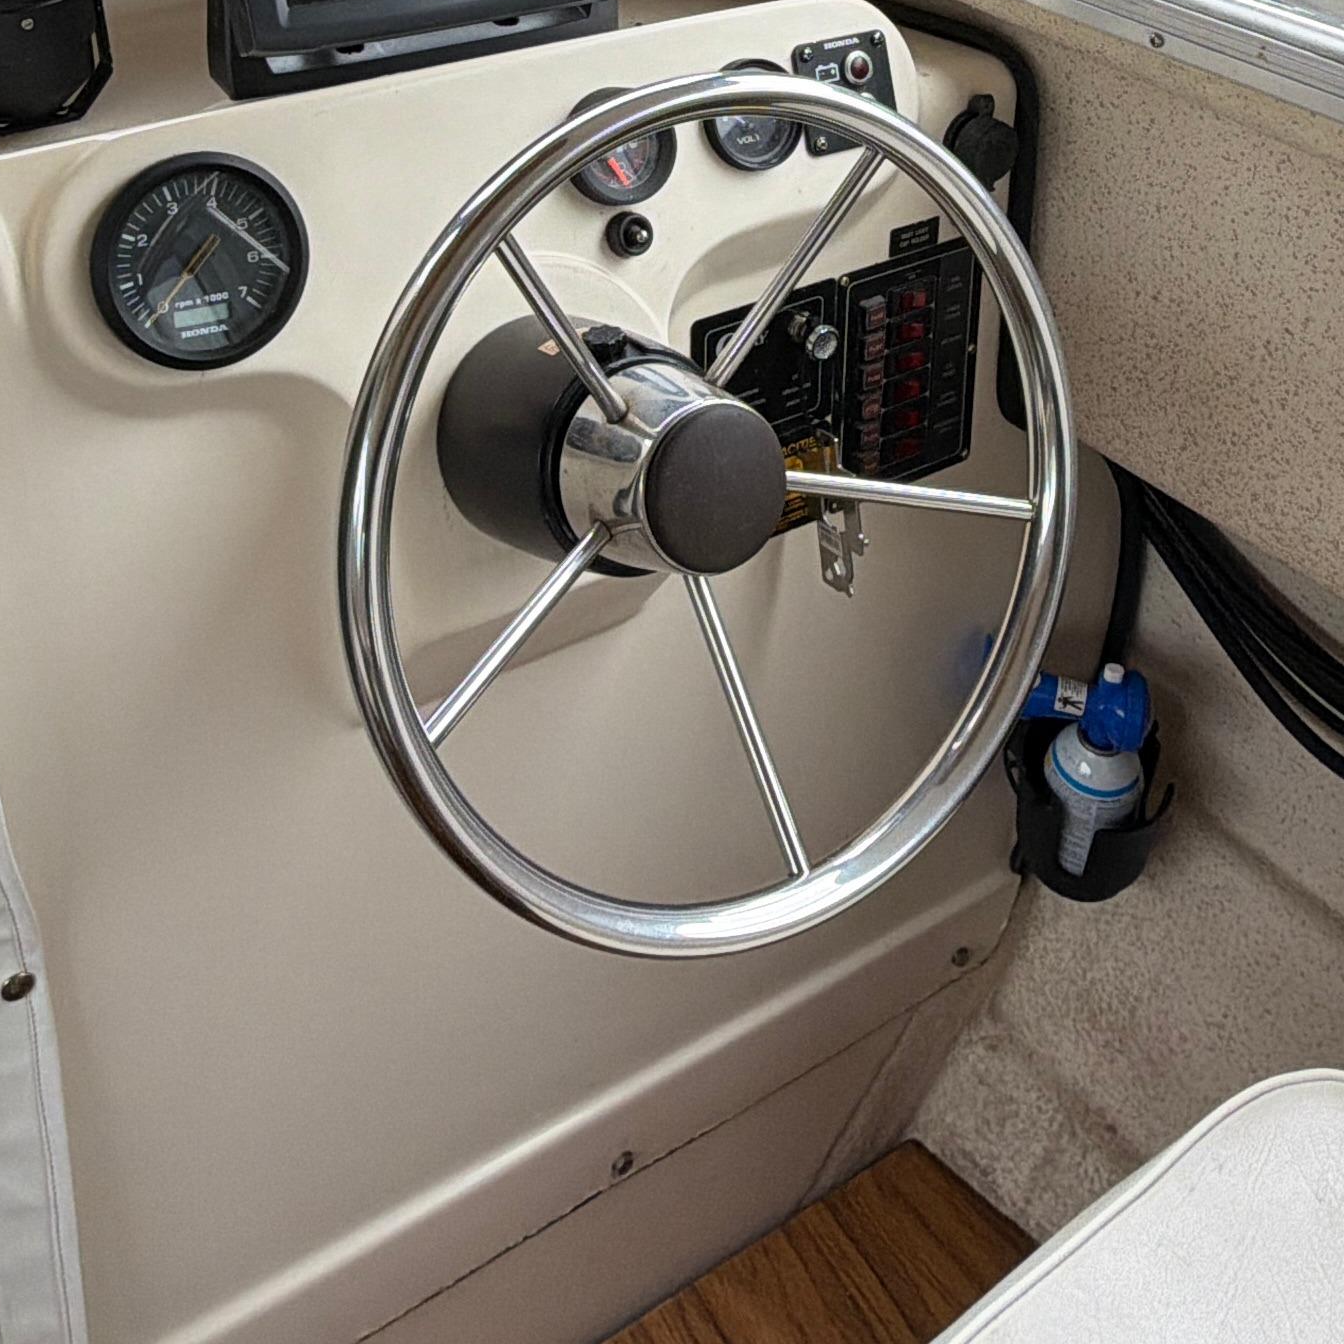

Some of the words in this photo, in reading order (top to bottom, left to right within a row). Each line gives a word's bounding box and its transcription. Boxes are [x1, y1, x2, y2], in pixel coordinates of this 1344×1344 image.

[823, 37, 860, 50] HONDA
[206, 196, 217, 208] 4
[166, 202, 179, 216] 3
[236, 217, 248, 231] 5
[137, 234, 150, 248] 2
[246, 250, 259, 263] 6
[135, 273, 144, 286] 1
[238, 286, 249, 299] 7
[175, 299, 194, 309] rpm
[203, 291, 229, 303] 1000
[181, 324, 230, 339] HONDA
